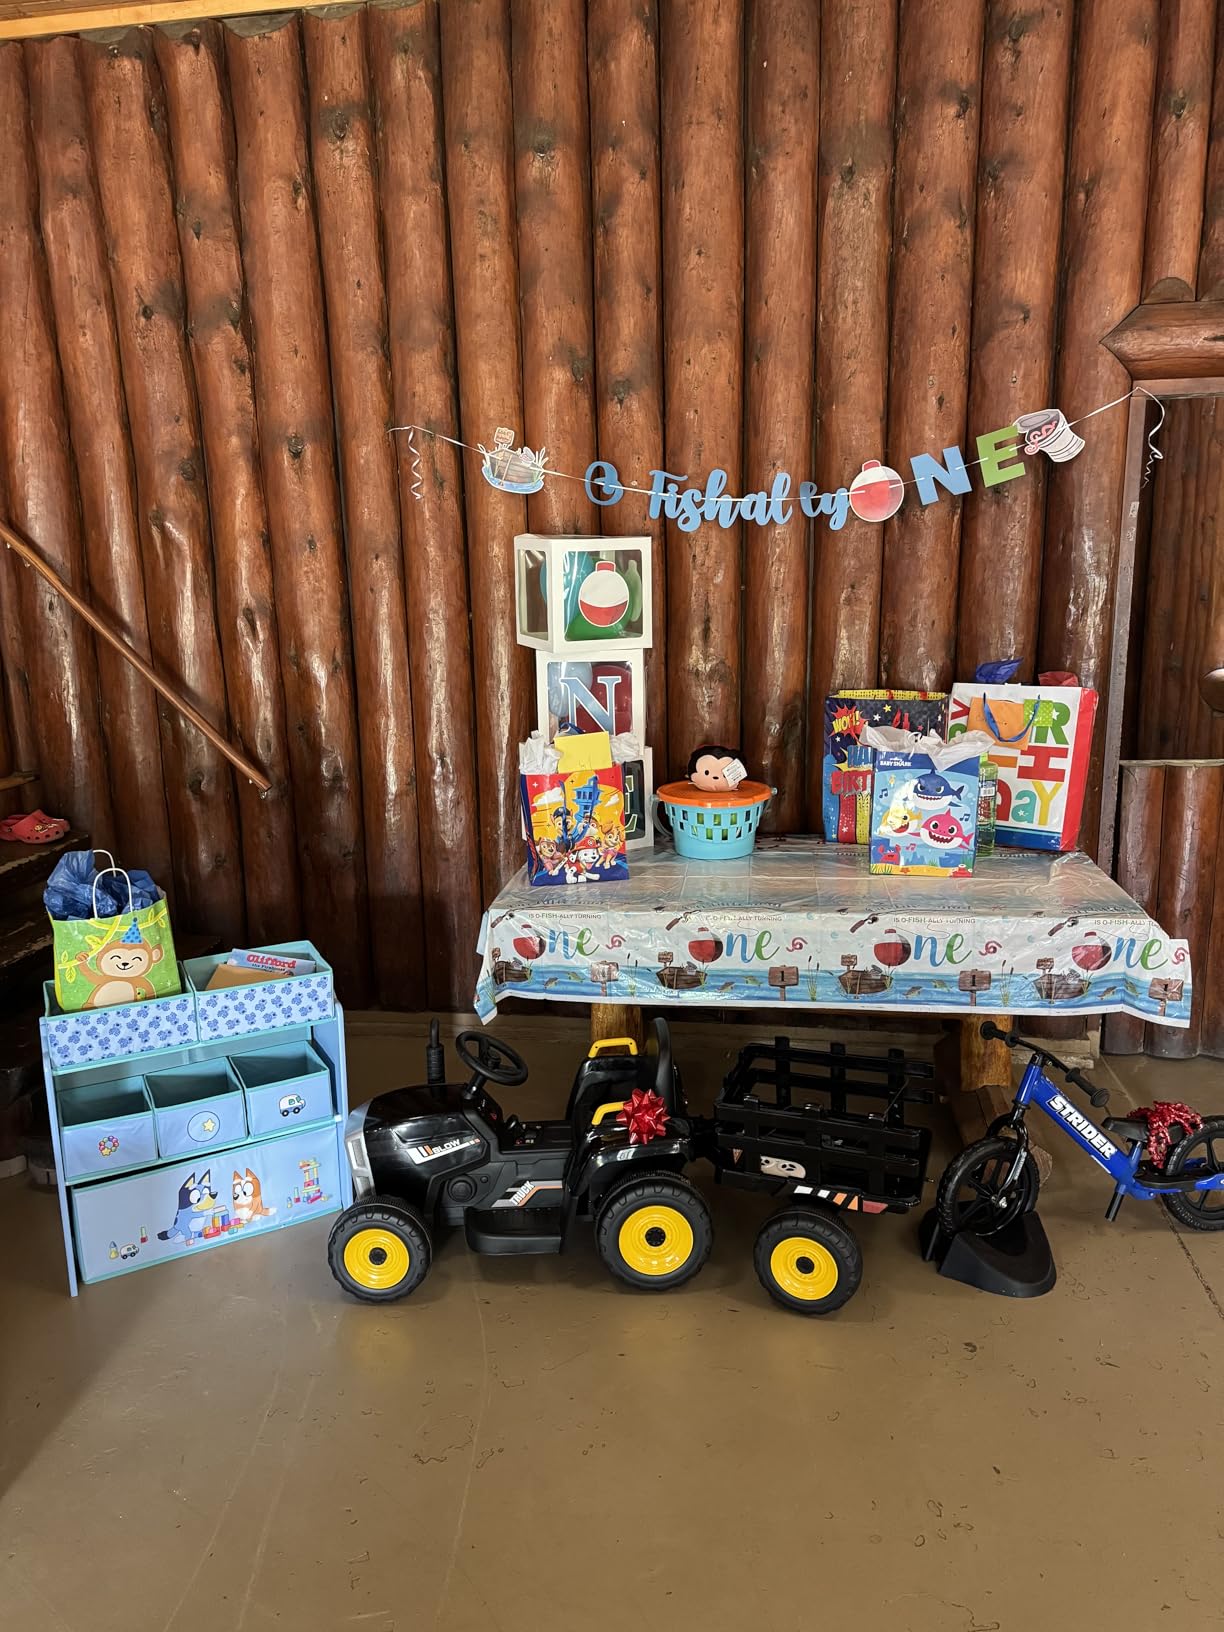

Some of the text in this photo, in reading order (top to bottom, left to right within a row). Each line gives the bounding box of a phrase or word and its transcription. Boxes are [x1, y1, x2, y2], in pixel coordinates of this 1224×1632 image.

[585, 460, 624, 506] O
[649, 469, 793, 532] Fishal
[559, 676, 621, 736] N
[246, 953, 297, 969] Clifford
[1047, 1095, 1118, 1160] STRIDER
[509, 1180, 535, 1206] TRUCK
